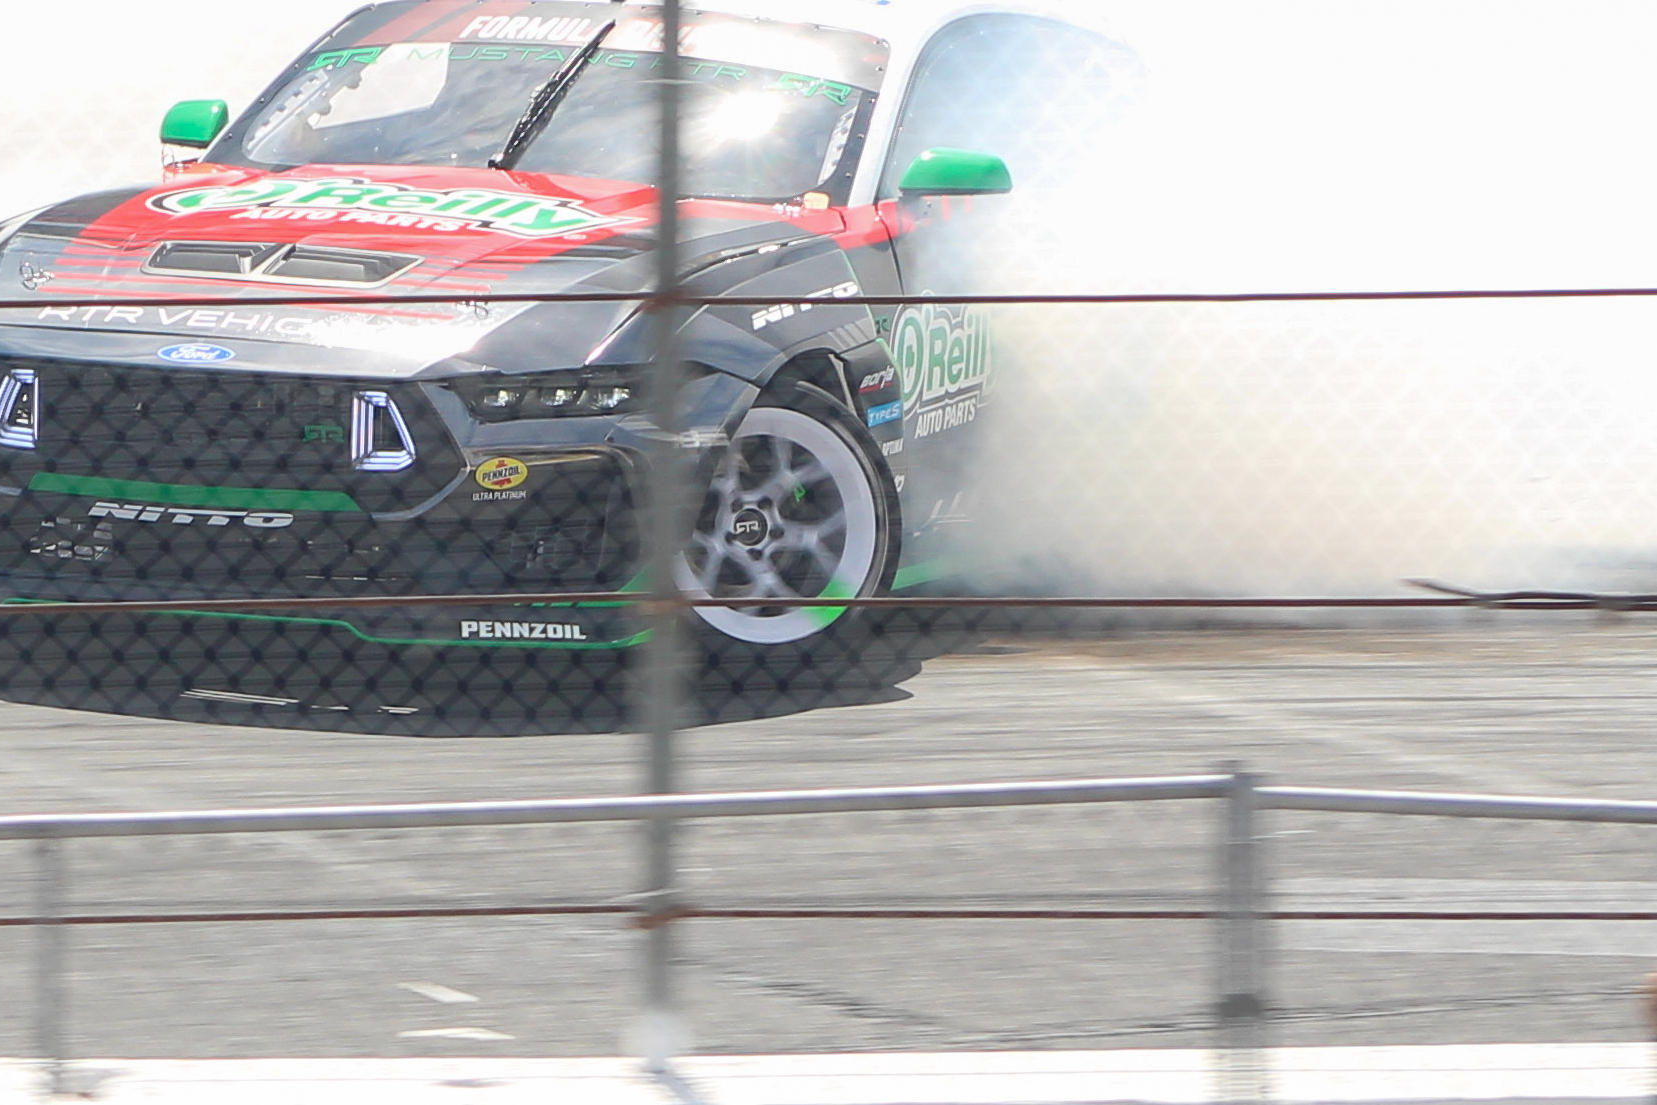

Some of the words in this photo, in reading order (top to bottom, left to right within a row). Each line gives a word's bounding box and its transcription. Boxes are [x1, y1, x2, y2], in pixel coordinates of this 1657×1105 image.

[174, 180, 590, 230] O'Reilly
[230, 207, 333, 224] AUTO
[338, 211, 463, 232] PARTS
[751, 281, 858, 331] NITO
[914, 409, 943, 439] AUTO
[943, 397, 976, 430] PARTS
[481, 465, 523, 482] PENNZOIL
[472, 492, 493, 502] ULTRA
[88, 501, 294, 529] NITTO
[460, 620, 587, 640] PENNZOIL
